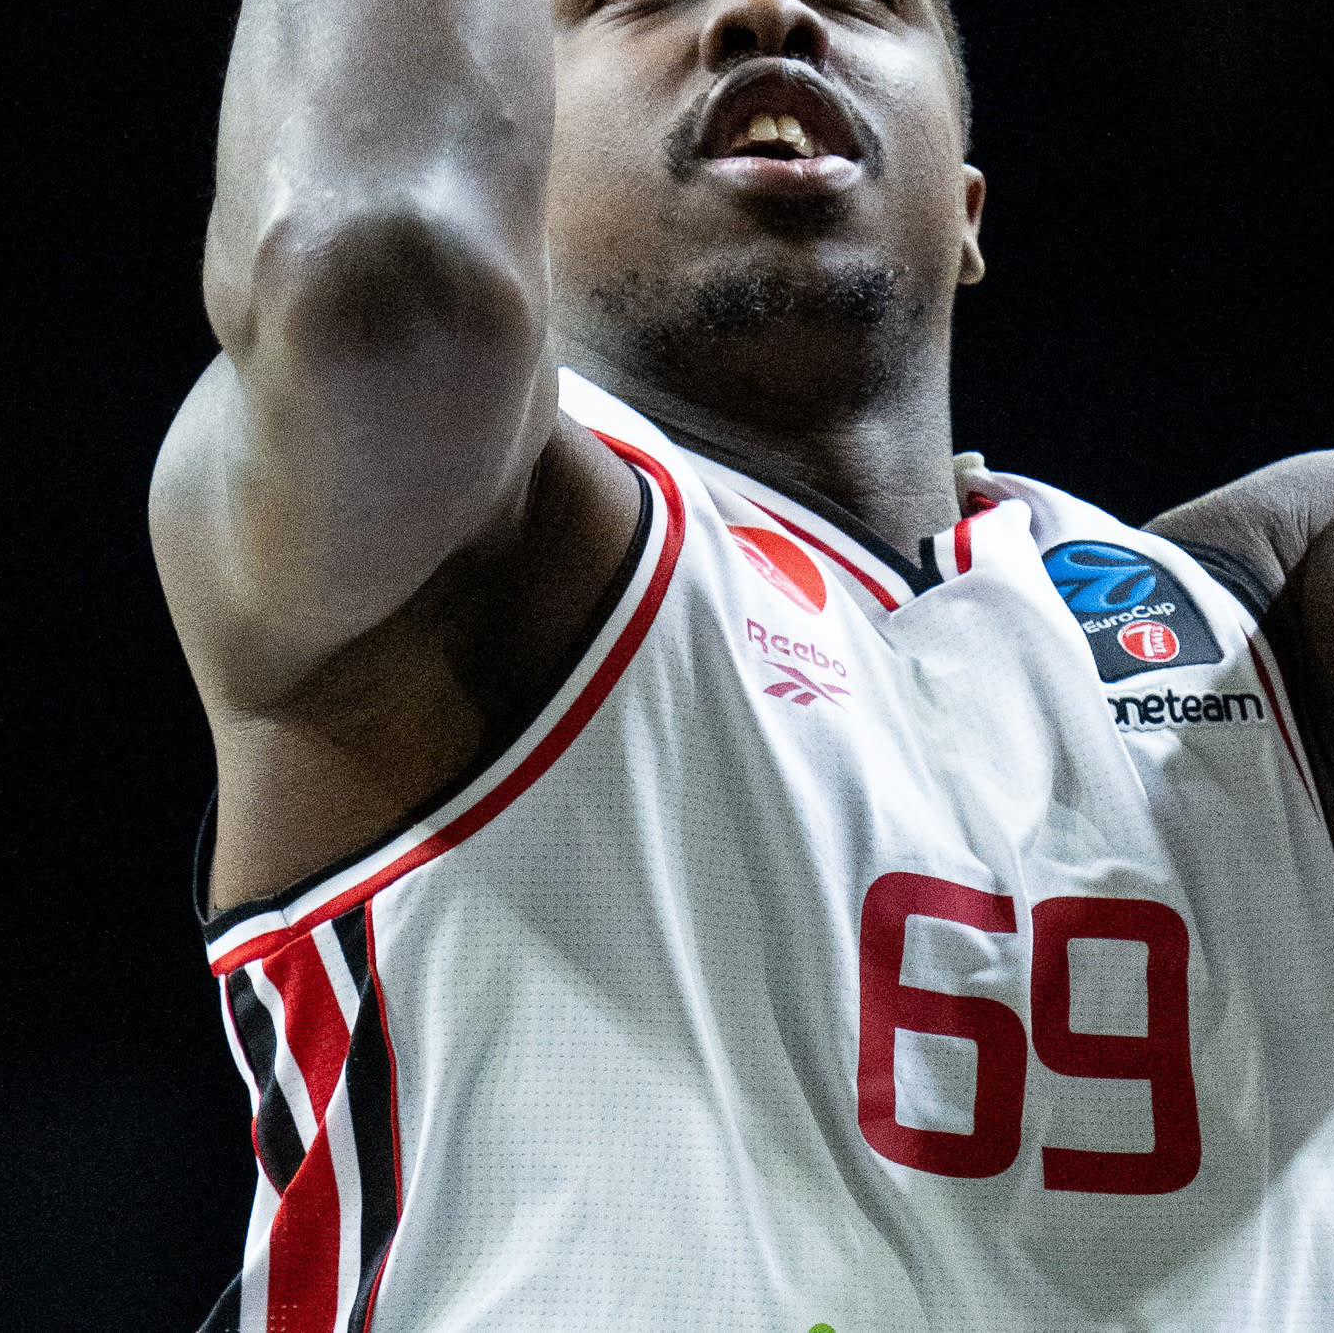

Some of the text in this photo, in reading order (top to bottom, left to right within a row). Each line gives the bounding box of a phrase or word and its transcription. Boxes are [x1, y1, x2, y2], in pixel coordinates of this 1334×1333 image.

[746, 617, 847, 678] Reebo
[1082, 602, 1176, 634] EuroCup
[857, 871, 1202, 1195] 69
